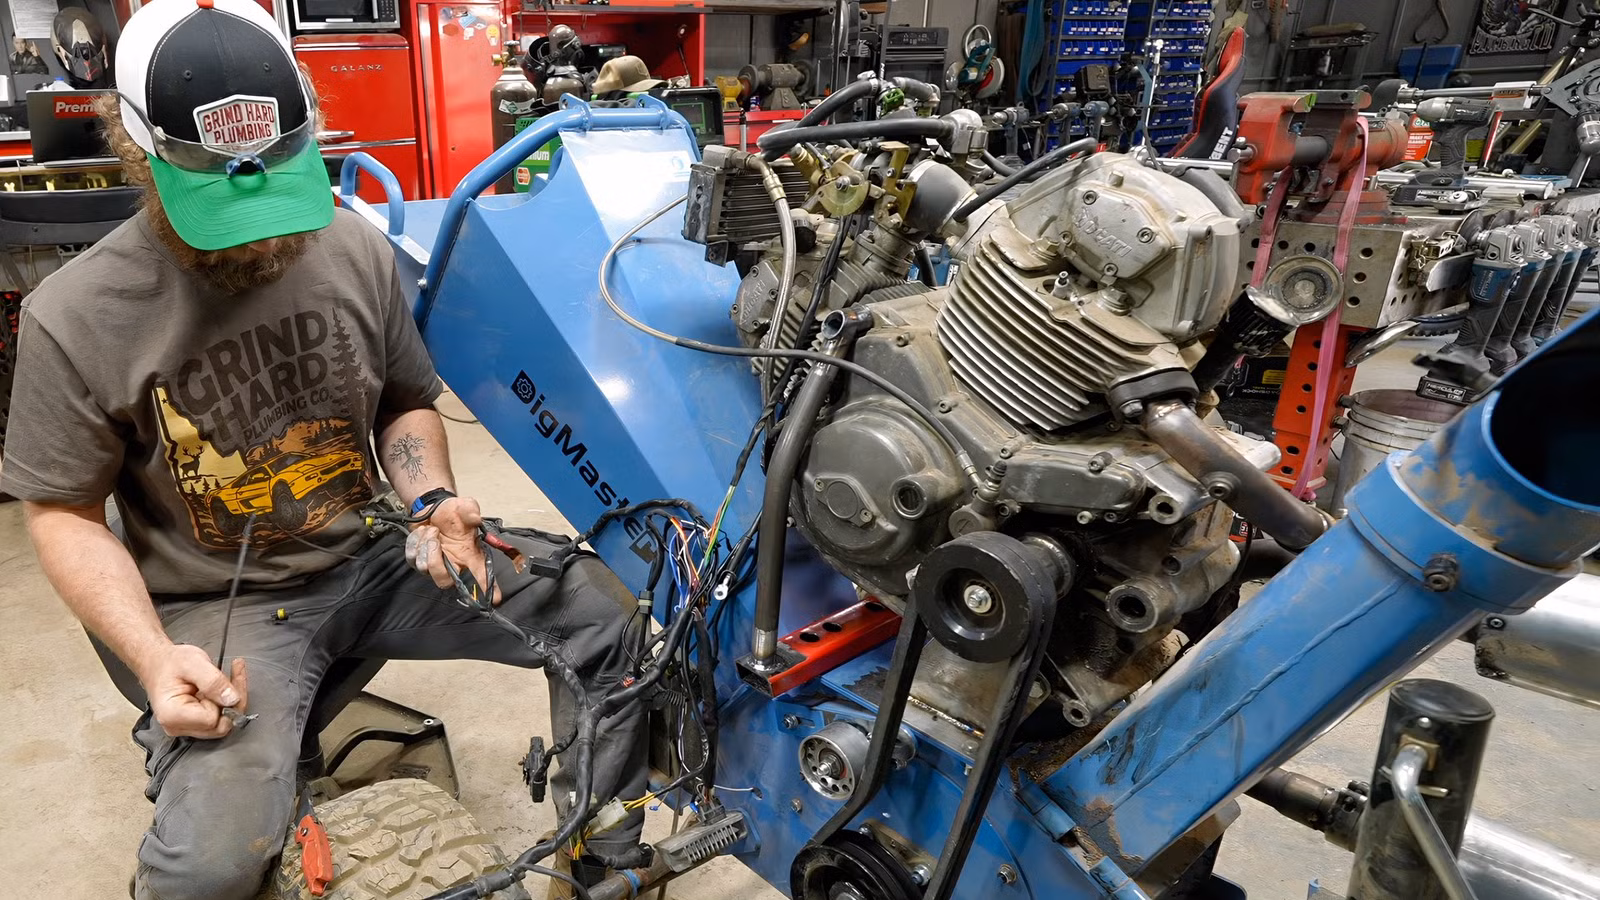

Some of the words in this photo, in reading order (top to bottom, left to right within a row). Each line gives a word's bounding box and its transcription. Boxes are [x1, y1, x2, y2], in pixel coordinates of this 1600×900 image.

[330, 64, 382, 72] GALANZ
[203, 103, 243, 133] GRIND
[245, 103, 275, 123] HARD
[213, 123, 272, 143] PLUMBING
[177, 310, 328, 416] GRIND
[210, 352, 328, 443] HARD
[242, 396, 307, 446] PLUMBING
[310, 387, 333, 405] CO.
